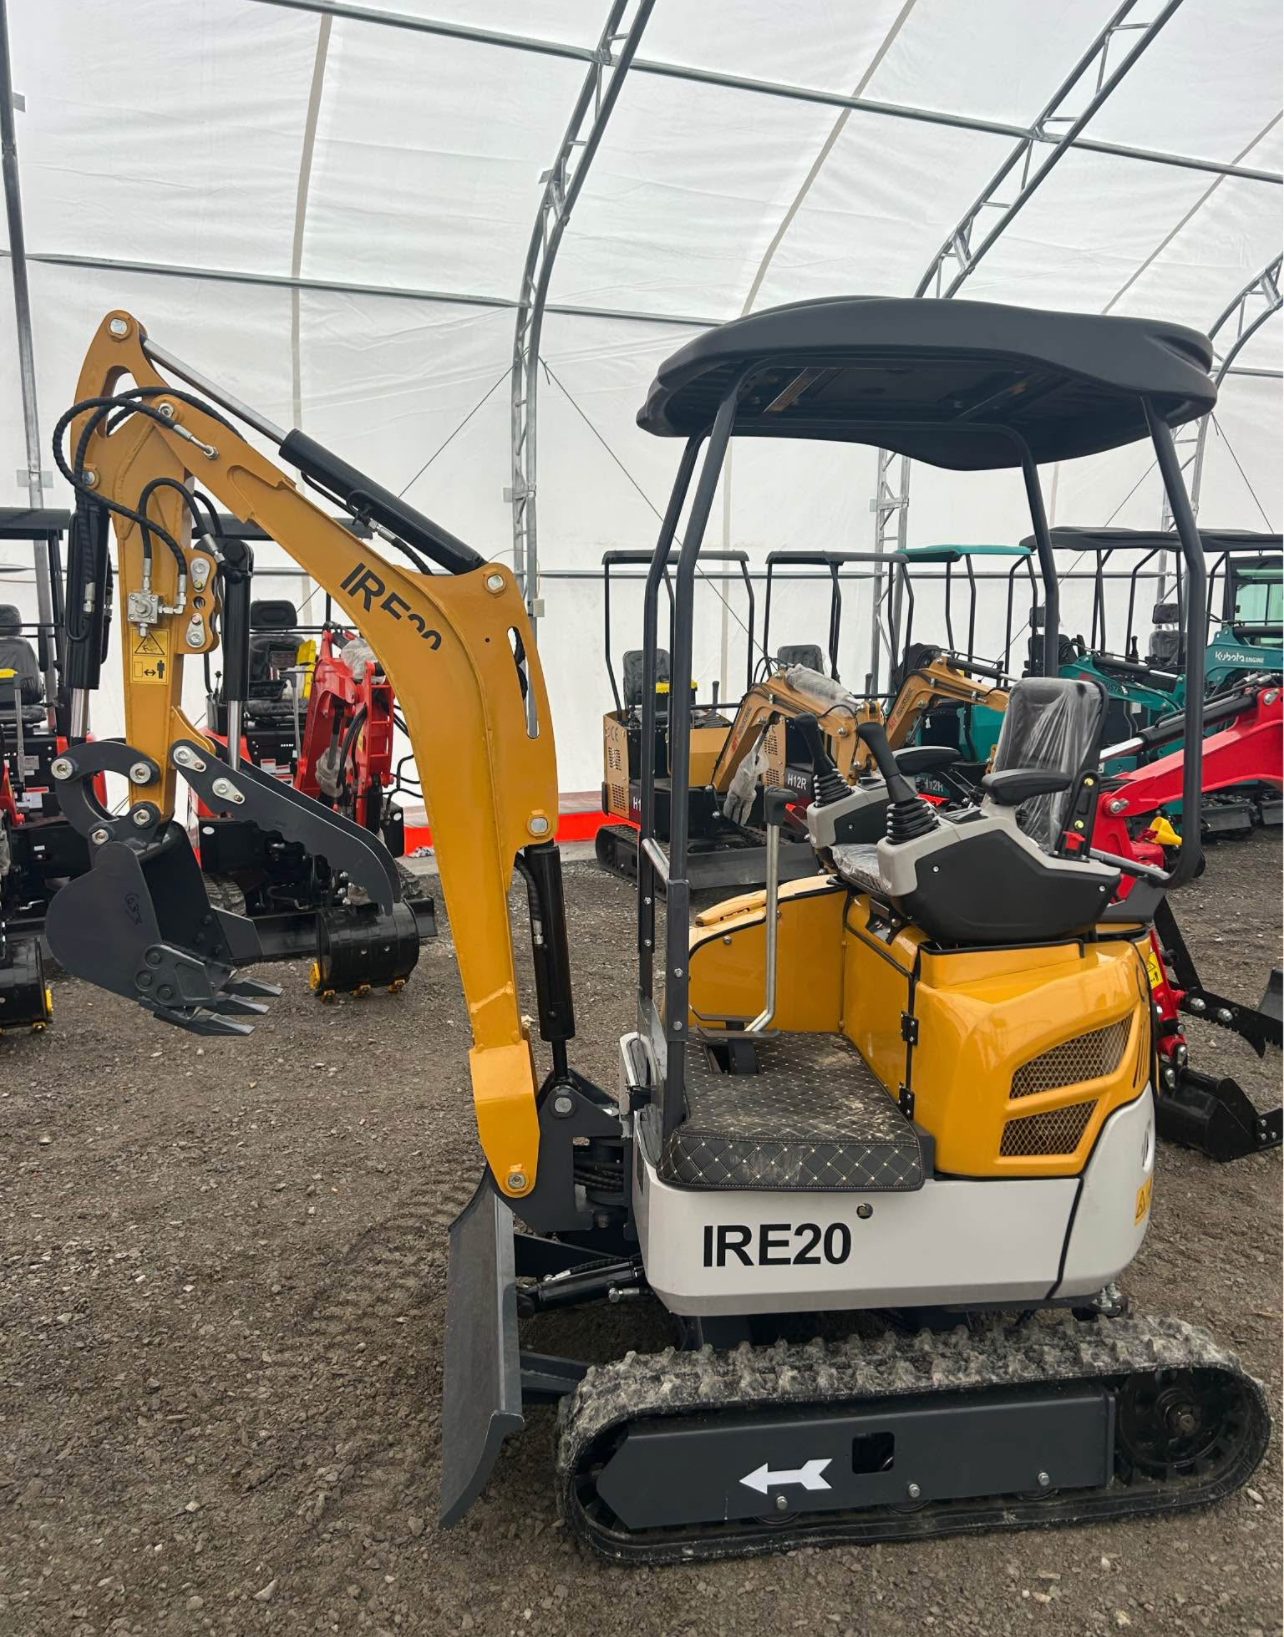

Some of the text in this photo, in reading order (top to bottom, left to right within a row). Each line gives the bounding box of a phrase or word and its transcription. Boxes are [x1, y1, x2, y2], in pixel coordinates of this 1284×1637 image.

[1215, 651, 1245, 662] Kubota
[787, 773, 807, 790] H12R
[703, 1222, 852, 1268] IRE20
